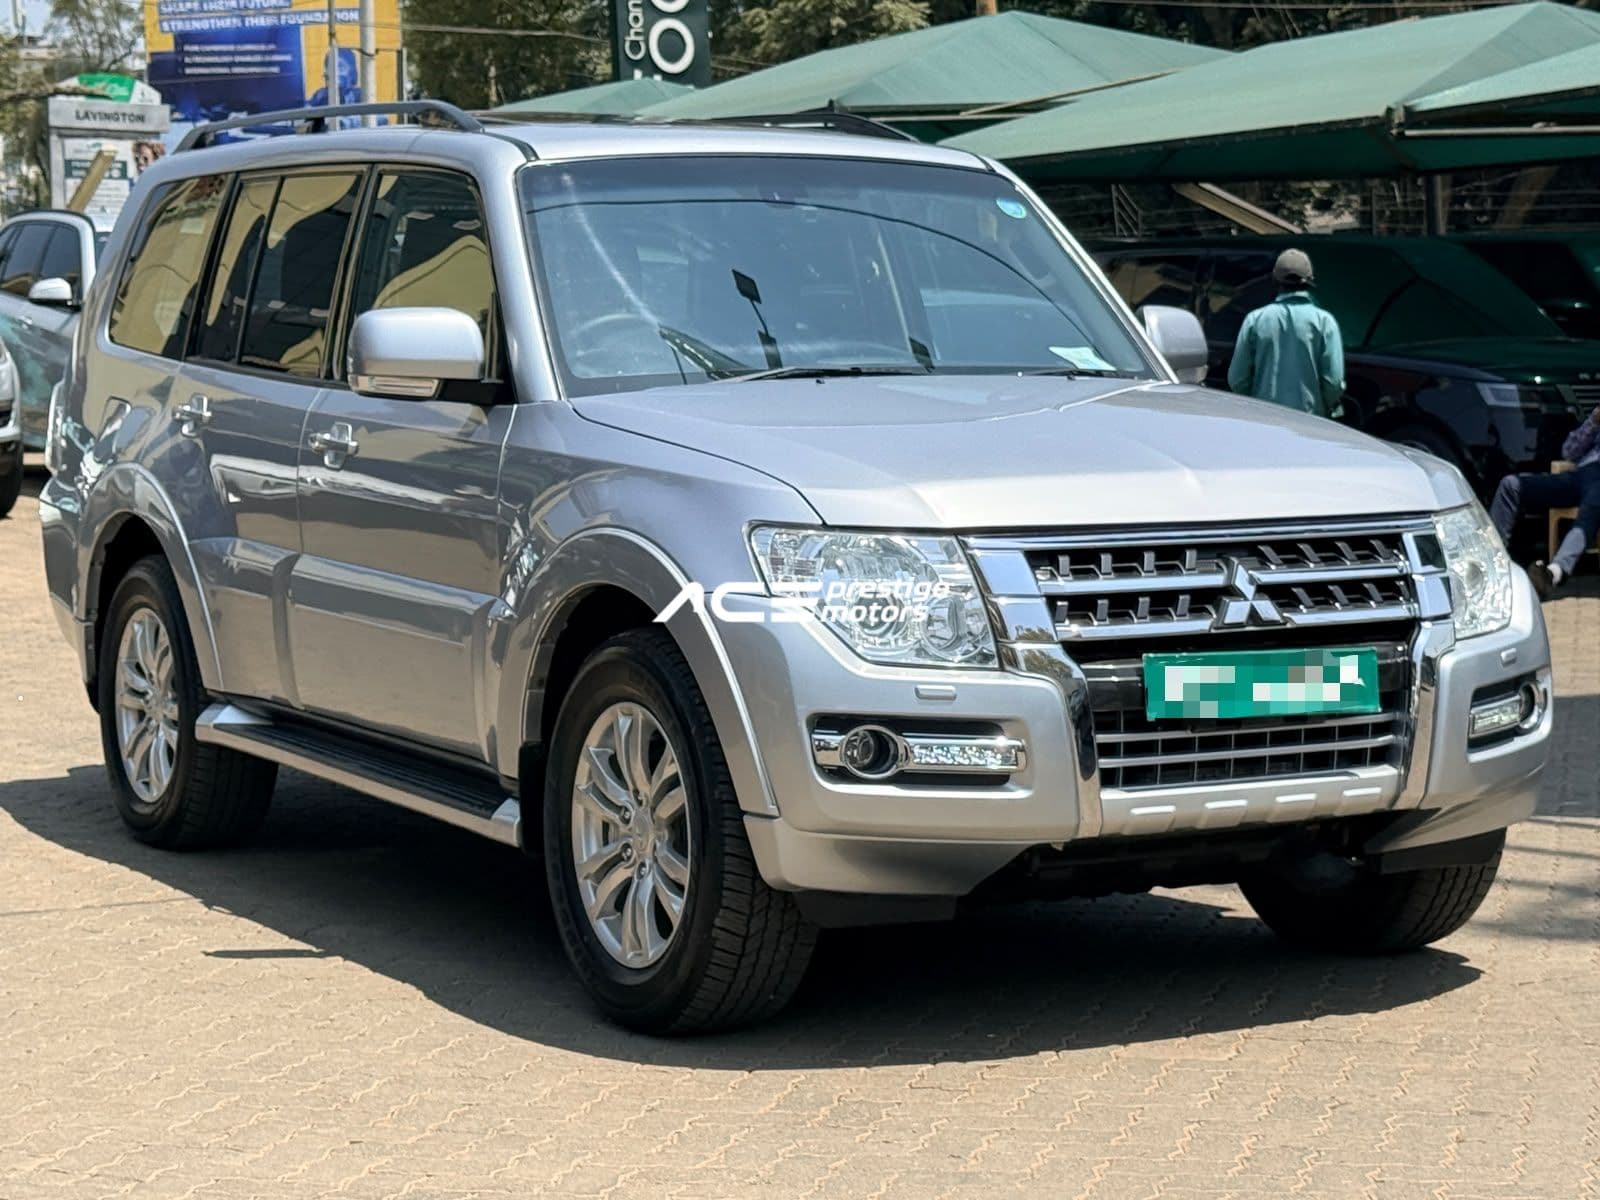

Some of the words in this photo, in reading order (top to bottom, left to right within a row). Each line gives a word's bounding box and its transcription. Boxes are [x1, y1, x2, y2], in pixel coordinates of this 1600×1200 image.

[161, 17, 242, 31] STRENGTHEN
[245, 15, 279, 27] THEIR
[75, 109, 145, 123] LAVINGTON
